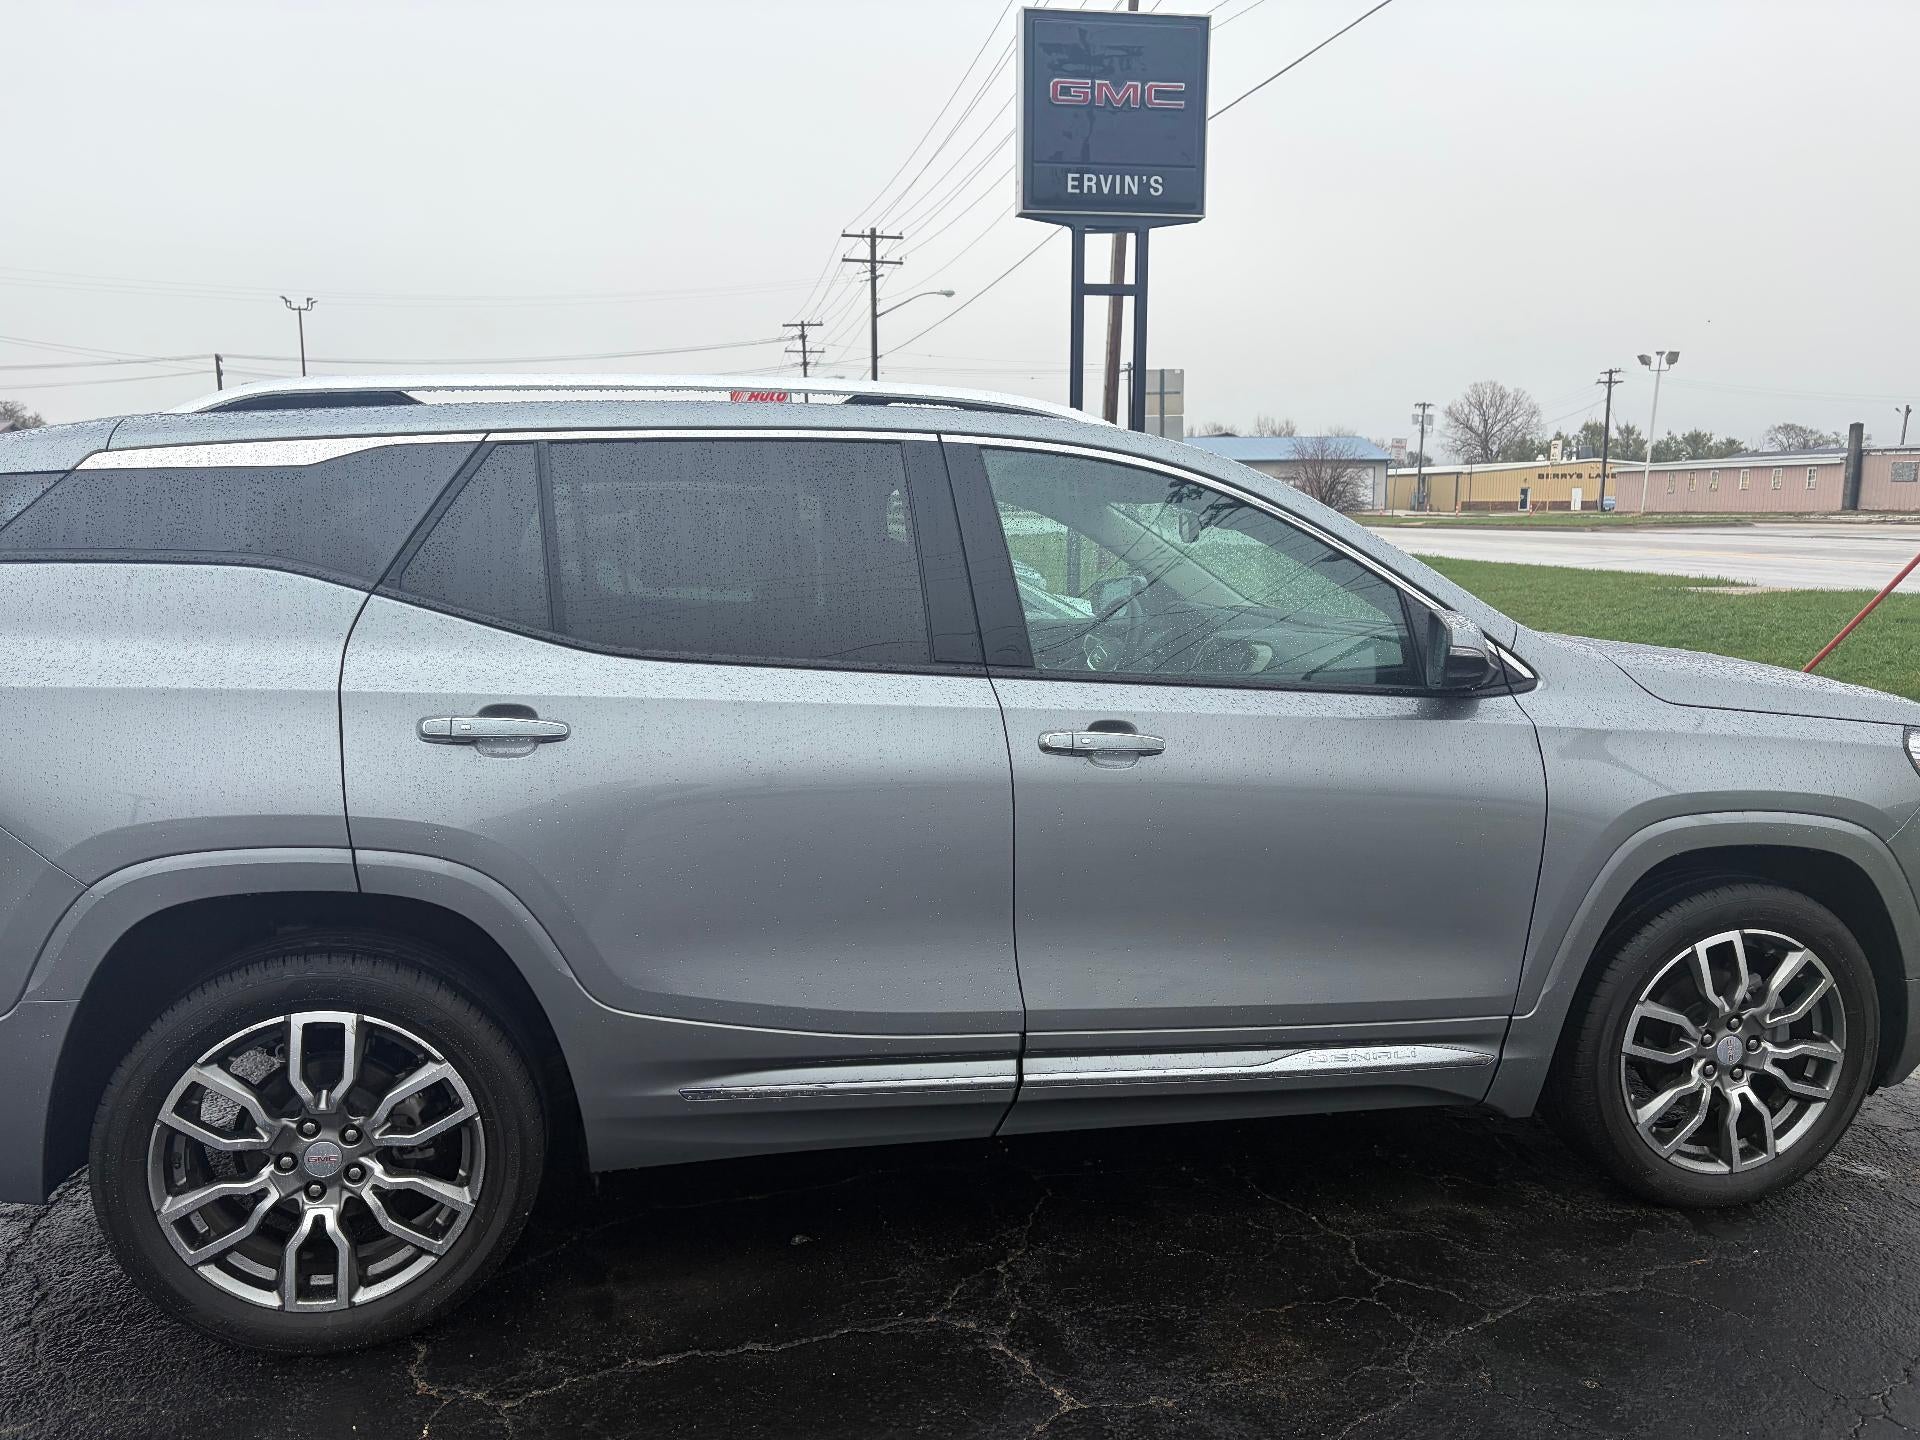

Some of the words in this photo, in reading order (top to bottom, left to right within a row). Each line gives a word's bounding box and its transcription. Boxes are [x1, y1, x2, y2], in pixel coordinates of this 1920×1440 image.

[1050, 78, 1185, 109] GMC
[1067, 173, 1164, 196] ERVIN'S
[1308, 1049, 1417, 1064] DENALI
[307, 1155, 338, 1164] GMC
